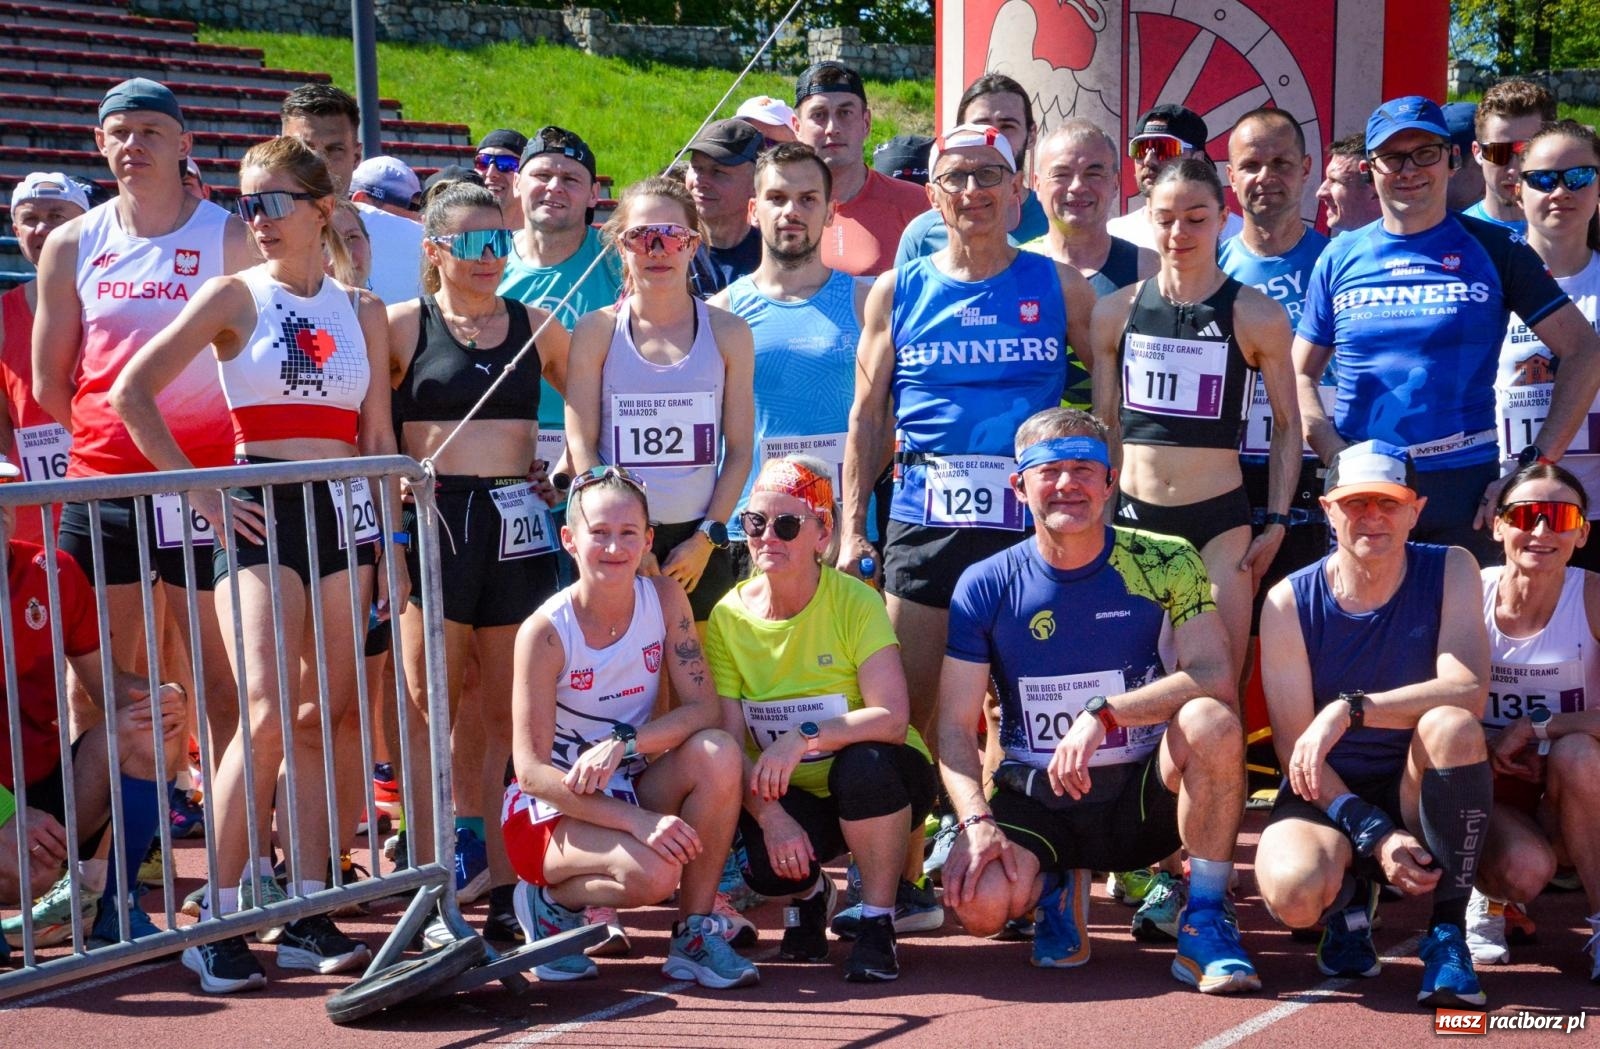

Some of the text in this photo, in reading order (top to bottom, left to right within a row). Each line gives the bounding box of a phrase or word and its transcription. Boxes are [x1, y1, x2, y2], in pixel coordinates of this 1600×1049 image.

[92, 252, 120, 268] 4F
[97, 281, 189, 301] POLSKA
[1332, 281, 1490, 315] RUNNERS
[1421, 306, 1459, 317] TEAM
[897, 336, 1060, 368] RUNNERS
[1146, 342, 1161, 351] BIEG
[1162, 344, 1175, 353] BEZ
[1176, 346, 1204, 355] GRANIC
[299, 373, 343, 381] LOVING
[1146, 370, 1178, 402] 111
[1509, 391, 1526, 400] XVIII
[1527, 389, 1544, 398] BIEG
[618, 398, 694, 408] XVIII BIEG BEZ GRANIC
[1509, 398, 1550, 409] 3MAJA2026
[618, 408, 658, 416] 3MAJA2026
[537, 434, 562, 443] GRANIC
[630, 426, 684, 455] 182
[766, 438, 838, 451] XVIII BIEG BEZ GRANIC
[965, 461, 979, 469] BEZ
[979, 461, 1006, 470] GRANIC
[942, 487, 993, 516] 129
[513, 514, 544, 546] 214
[1495, 666, 1512, 675] BIEG
[1514, 668, 1528, 676] BEZ
[1529, 668, 1560, 677] GRANIC
[1025, 679, 1100, 693] XVIII BIEG BEZ GRANIC
[1026, 693, 1063, 702] 3MAJA2026
[749, 703, 824, 714] XVIII BIEG BEZ GRANIC
